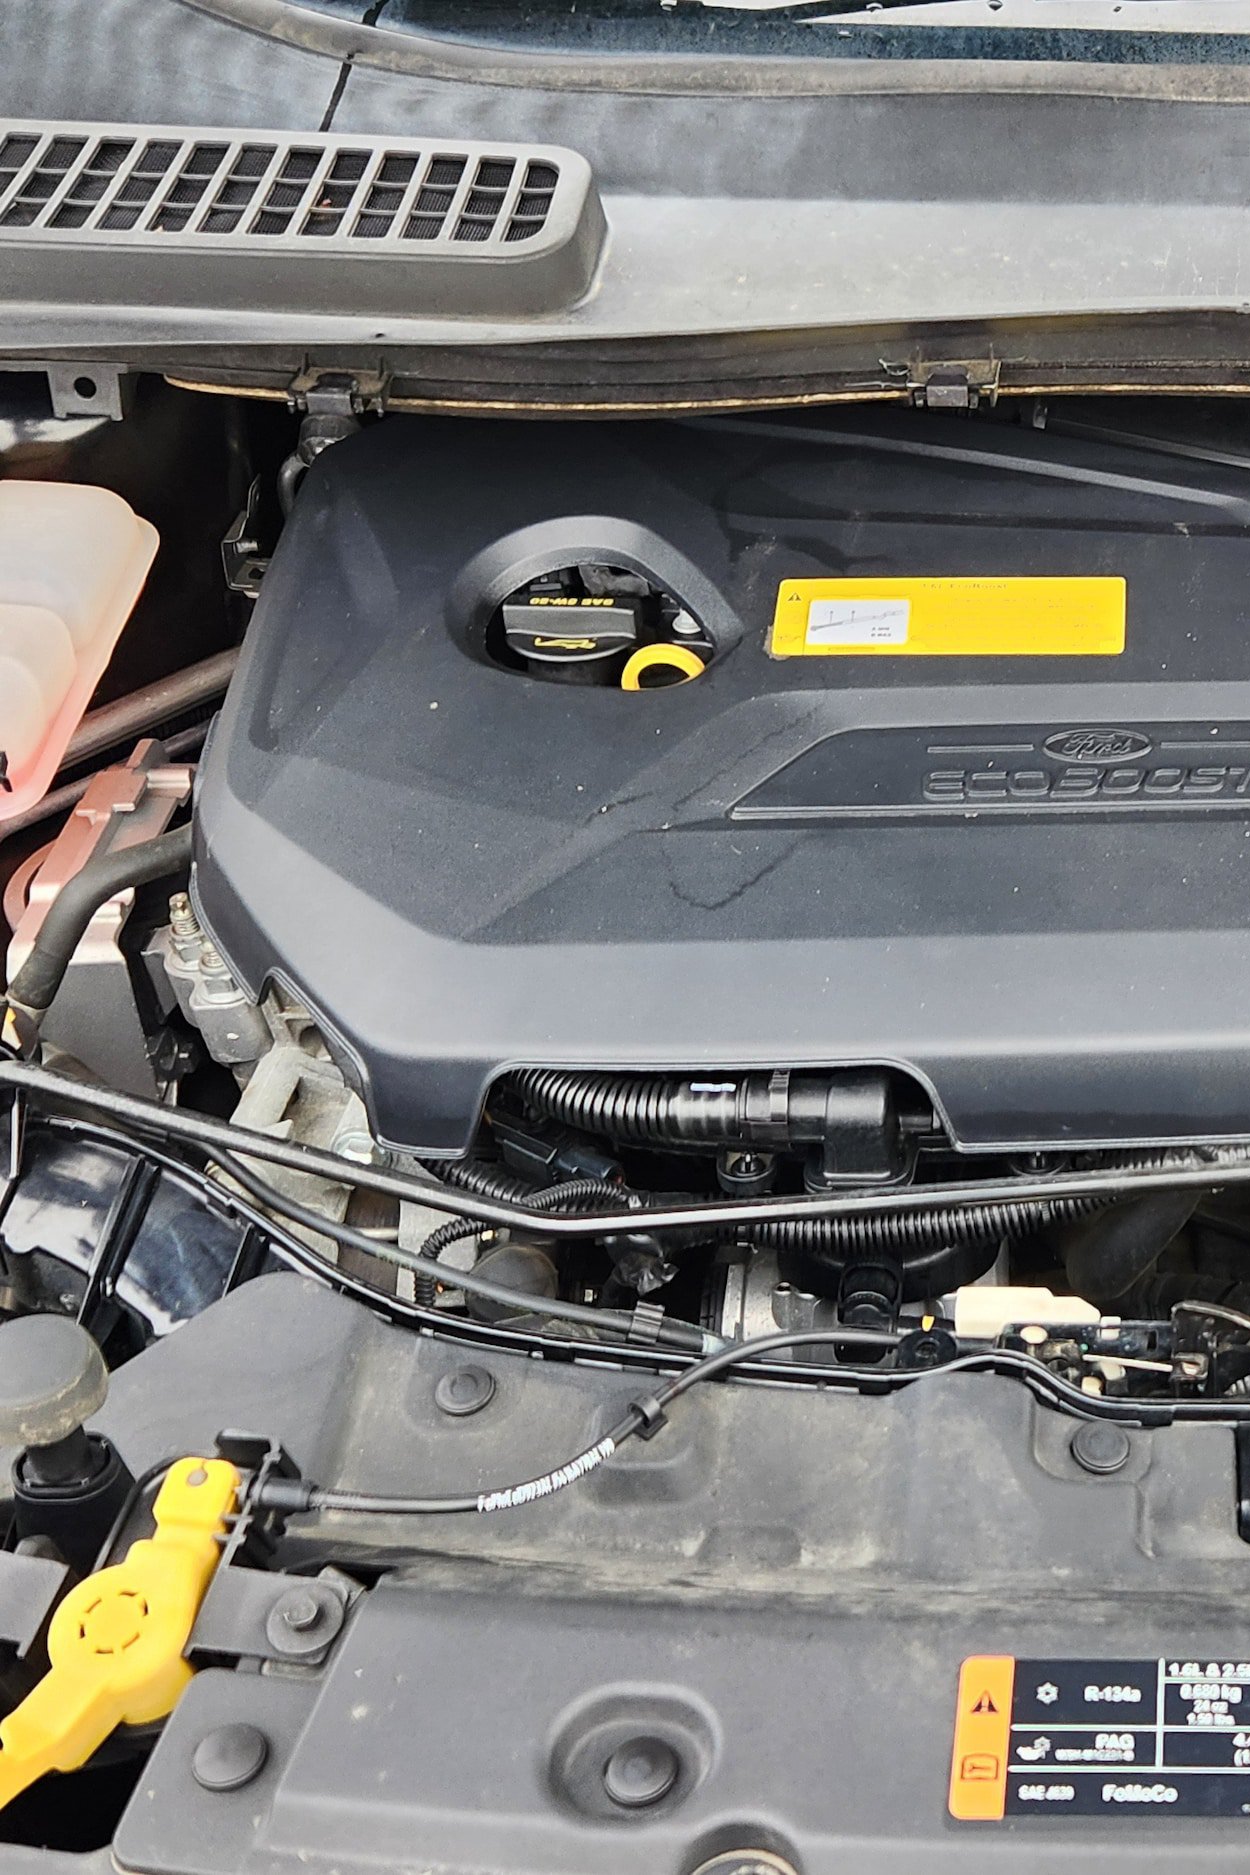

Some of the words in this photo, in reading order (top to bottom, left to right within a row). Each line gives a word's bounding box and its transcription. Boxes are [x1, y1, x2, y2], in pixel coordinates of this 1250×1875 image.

[1061, 731, 1133, 757] Ford
[1083, 1685, 1142, 1702] R-134a
[1220, 1684, 1242, 1704] kg
[1211, 1701, 1229, 1714] oz
[1095, 1733, 1135, 1750] PAG
[1101, 1783, 1179, 1803] FoMoCo
